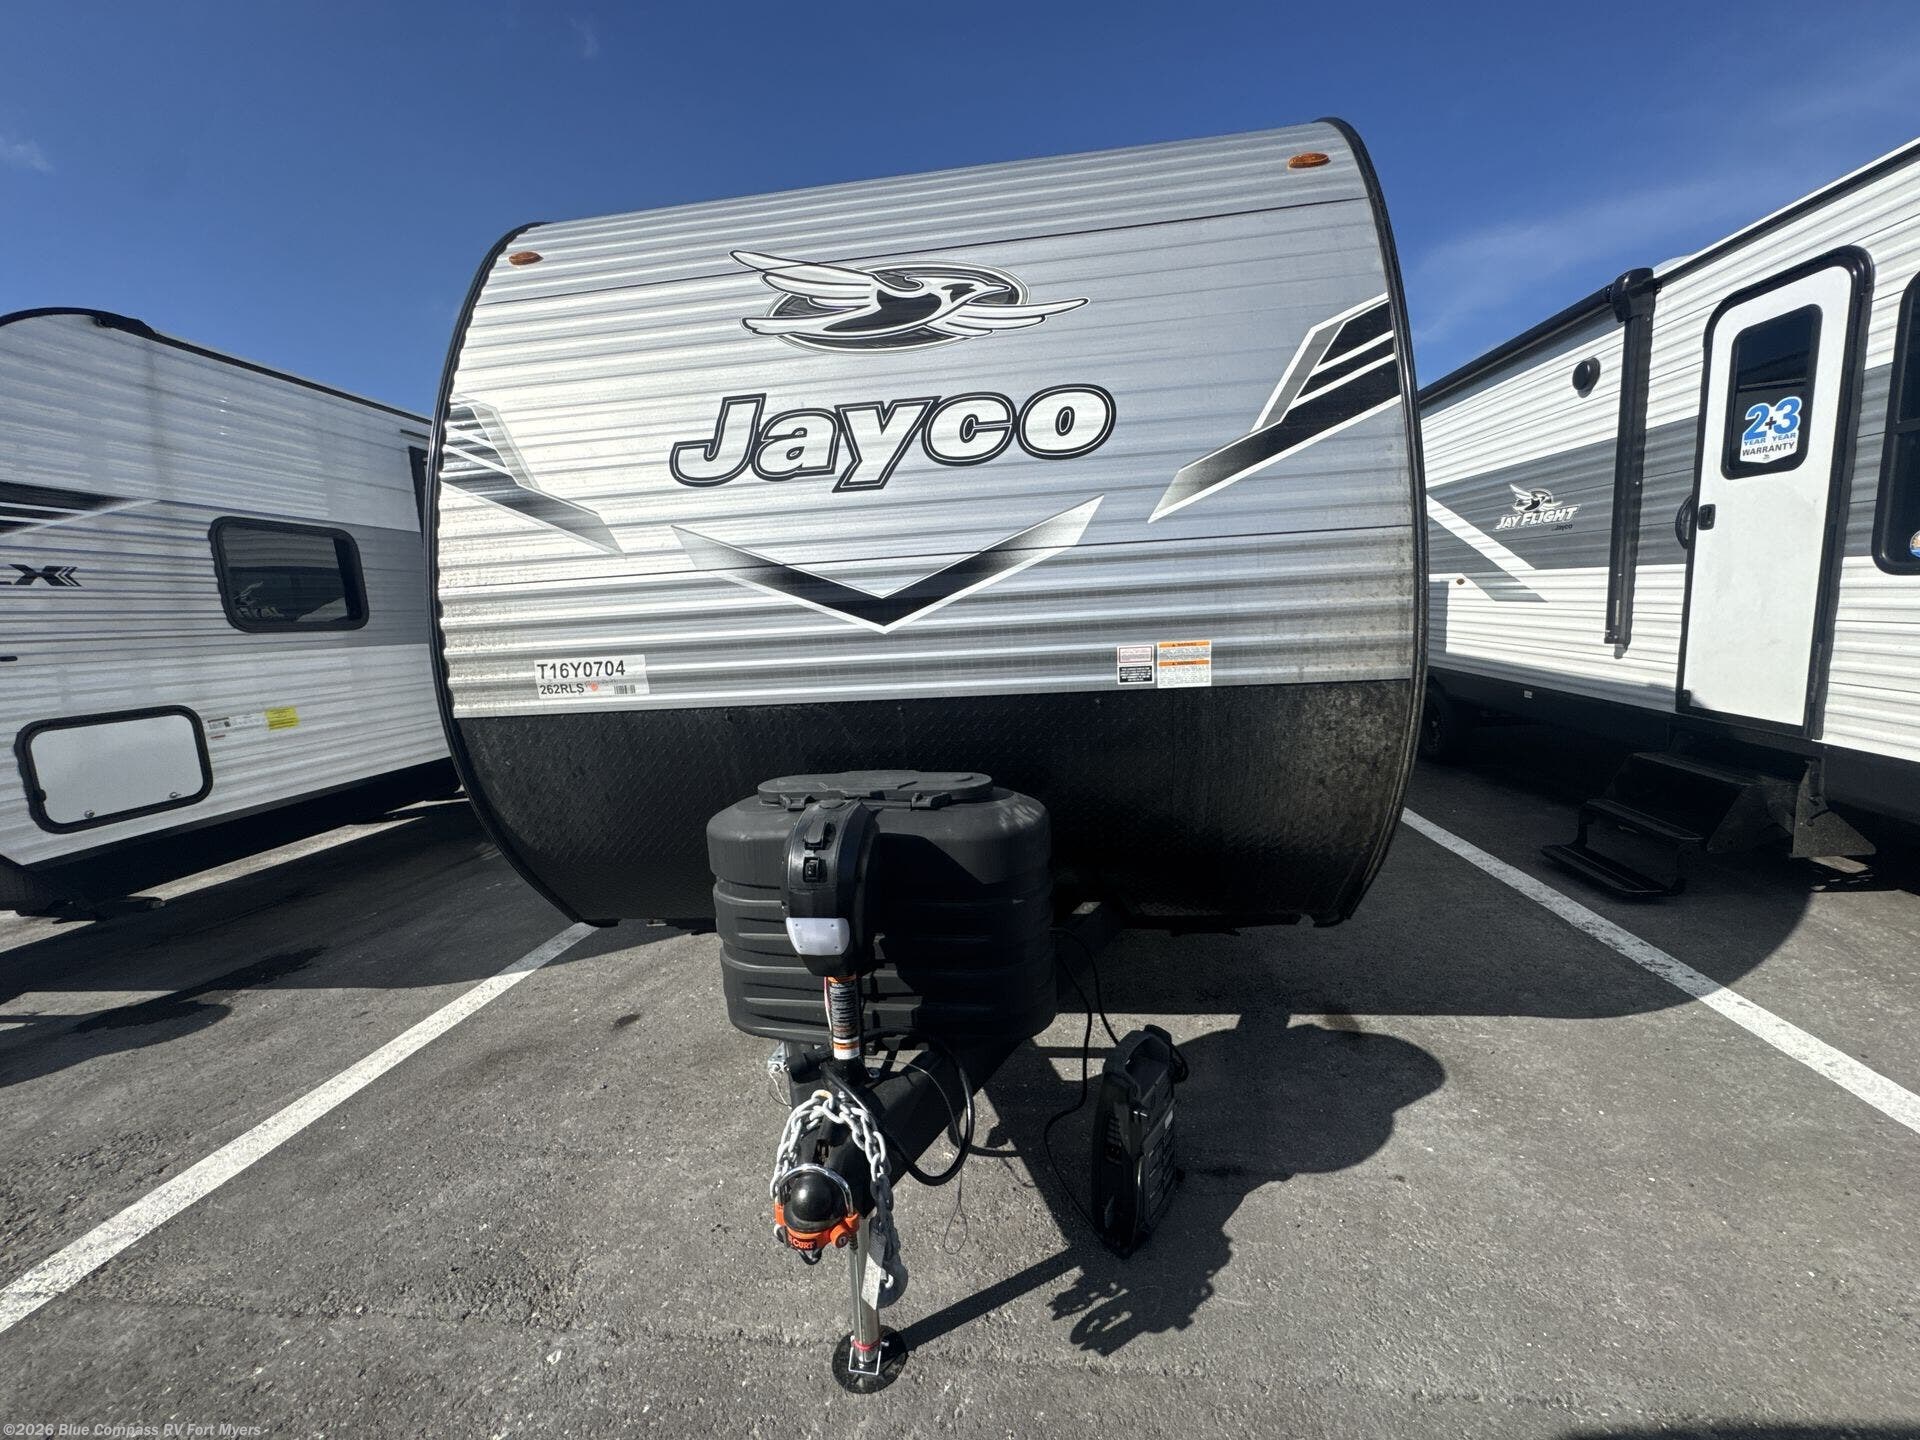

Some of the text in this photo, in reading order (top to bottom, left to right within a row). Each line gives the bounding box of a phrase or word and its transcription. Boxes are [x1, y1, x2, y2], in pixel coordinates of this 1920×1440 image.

[669, 383, 1117, 493] Jayco
[1744, 433, 1797, 446] YEAR YEAR
[1742, 442, 1795, 456] WARRANTY
[1494, 506, 1579, 531] JAY FLIGHT
[536, 660, 626, 679] T16Y0704
[539, 682, 585, 695] 262RLS
[792, 1238, 815, 1249] CURT
